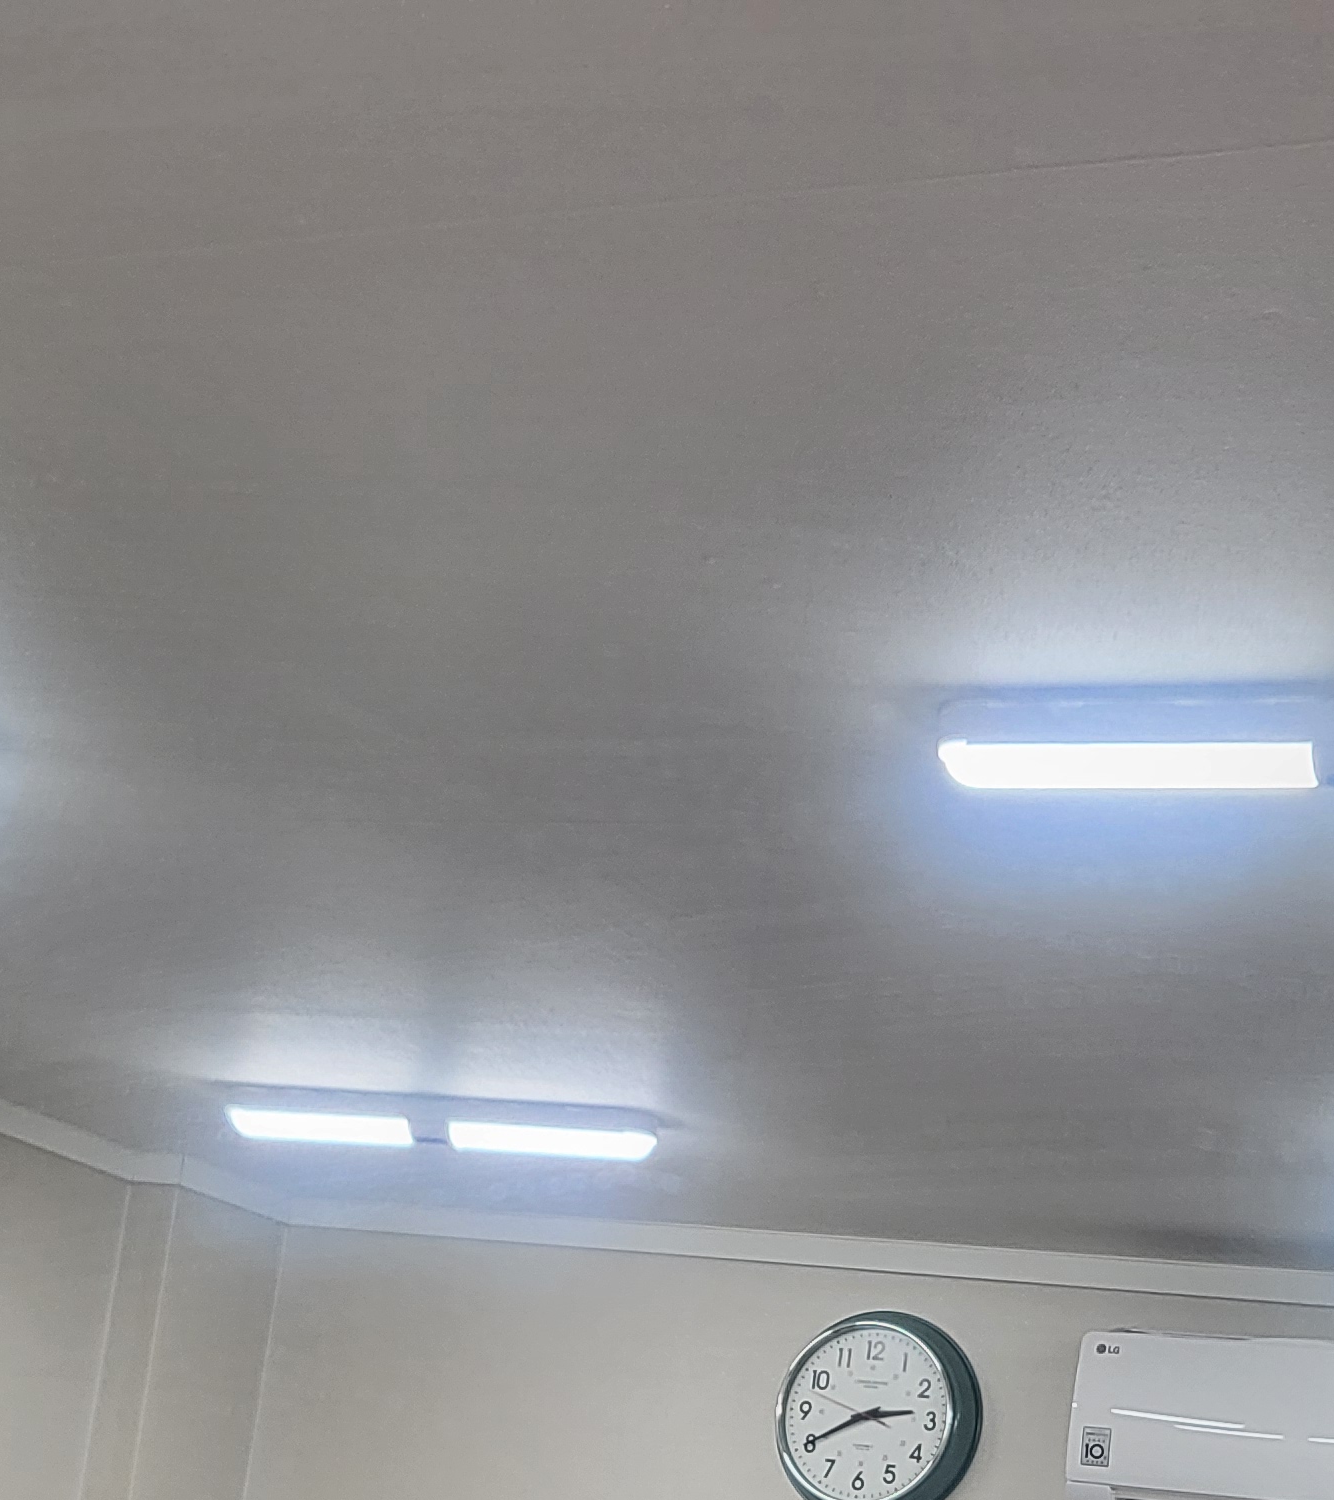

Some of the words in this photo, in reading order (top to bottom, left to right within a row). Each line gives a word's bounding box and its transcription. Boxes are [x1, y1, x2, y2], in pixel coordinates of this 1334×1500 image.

[837, 1347, 853, 1369] 11
[866, 1339, 886, 1361] 12
[901, 1351, 909, 1373] 1
[811, 1369, 831, 1391] 10
[917, 1378, 932, 1399] 2
[799, 1400, 813, 1421] 9
[923, 1410, 937, 1431] 3
[803, 1433, 817, 1454] 8
[908, 1443, 923, 1464] 4
[1084, 1442, 1105, 1460] 10
[824, 1458, 836, 1479] 7
[882, 1463, 896, 1485] 5
[851, 1470, 865, 1491] 6
